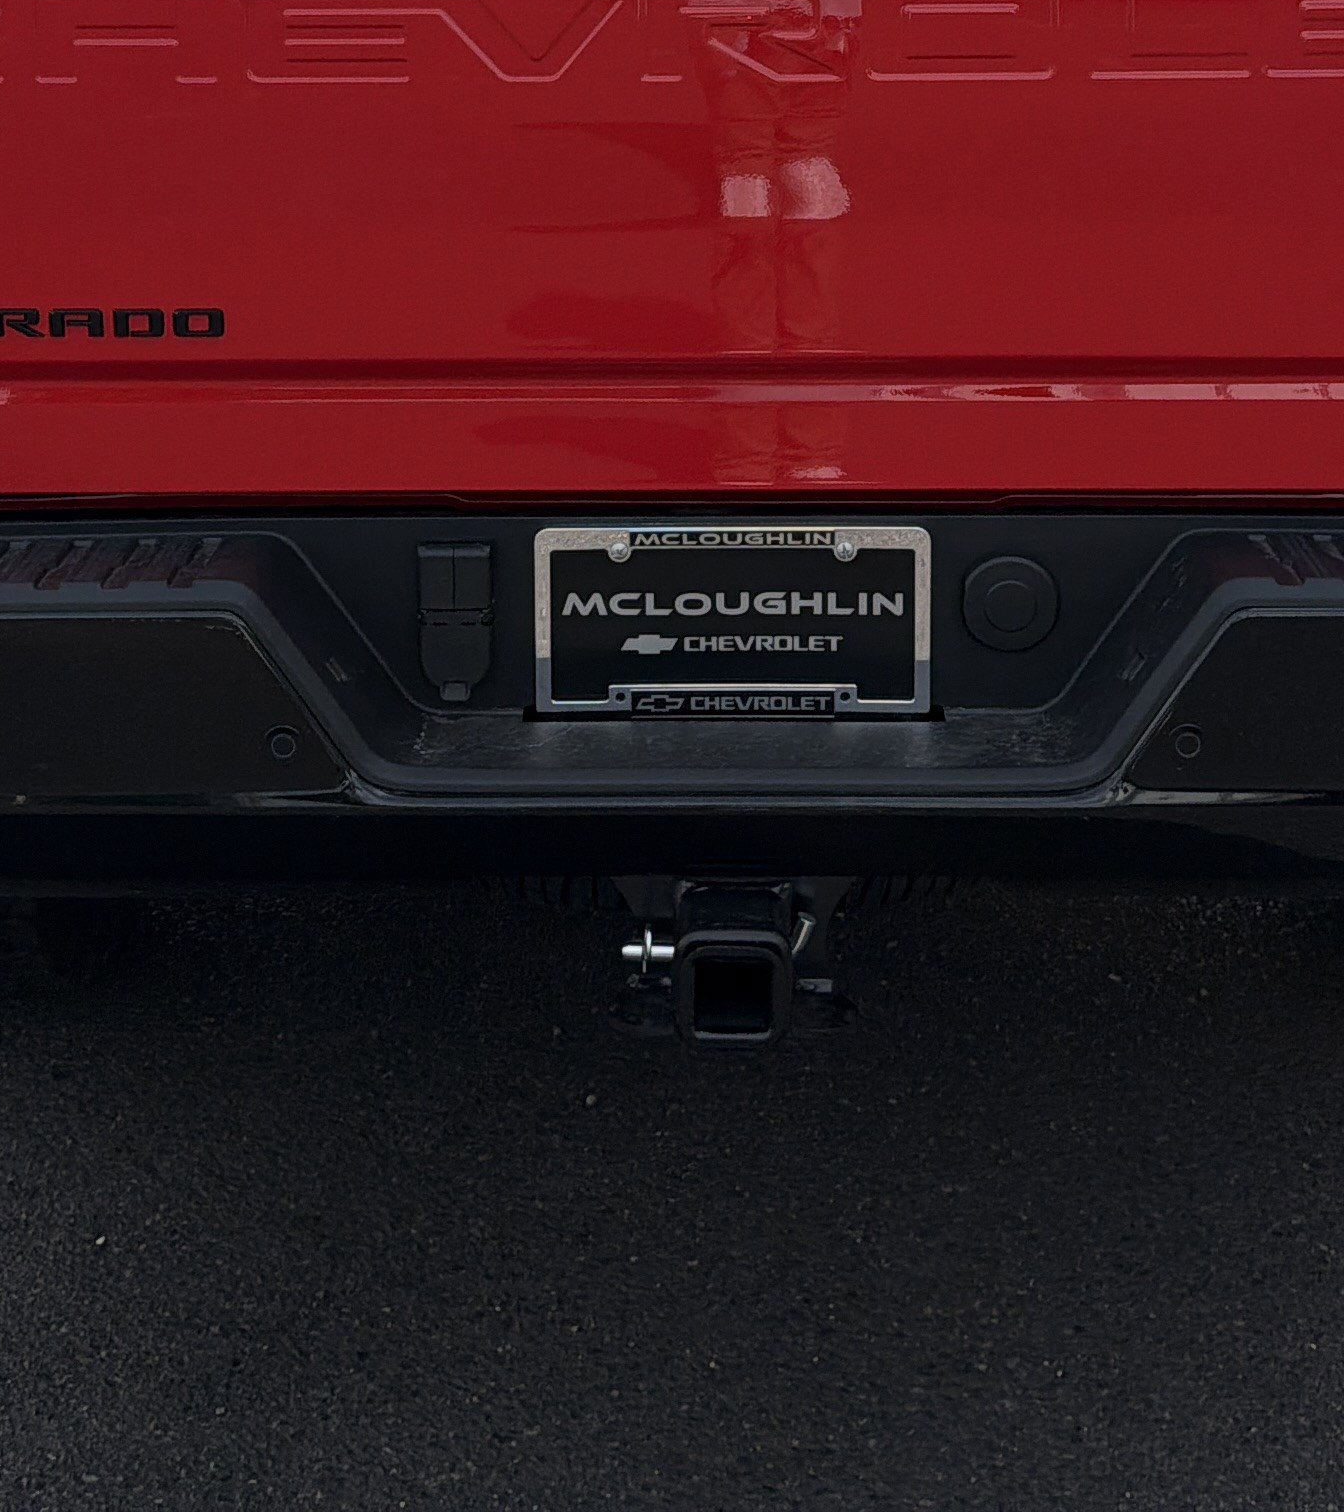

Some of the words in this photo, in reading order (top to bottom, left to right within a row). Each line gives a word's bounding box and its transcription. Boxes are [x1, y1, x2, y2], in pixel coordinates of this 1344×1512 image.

[633, 531, 833, 547] MCLOUGHLIN
[561, 590, 904, 618] MCLOUGHLIN
[683, 634, 843, 653] CHEVROLET
[690, 695, 833, 713] CHEVROLET
